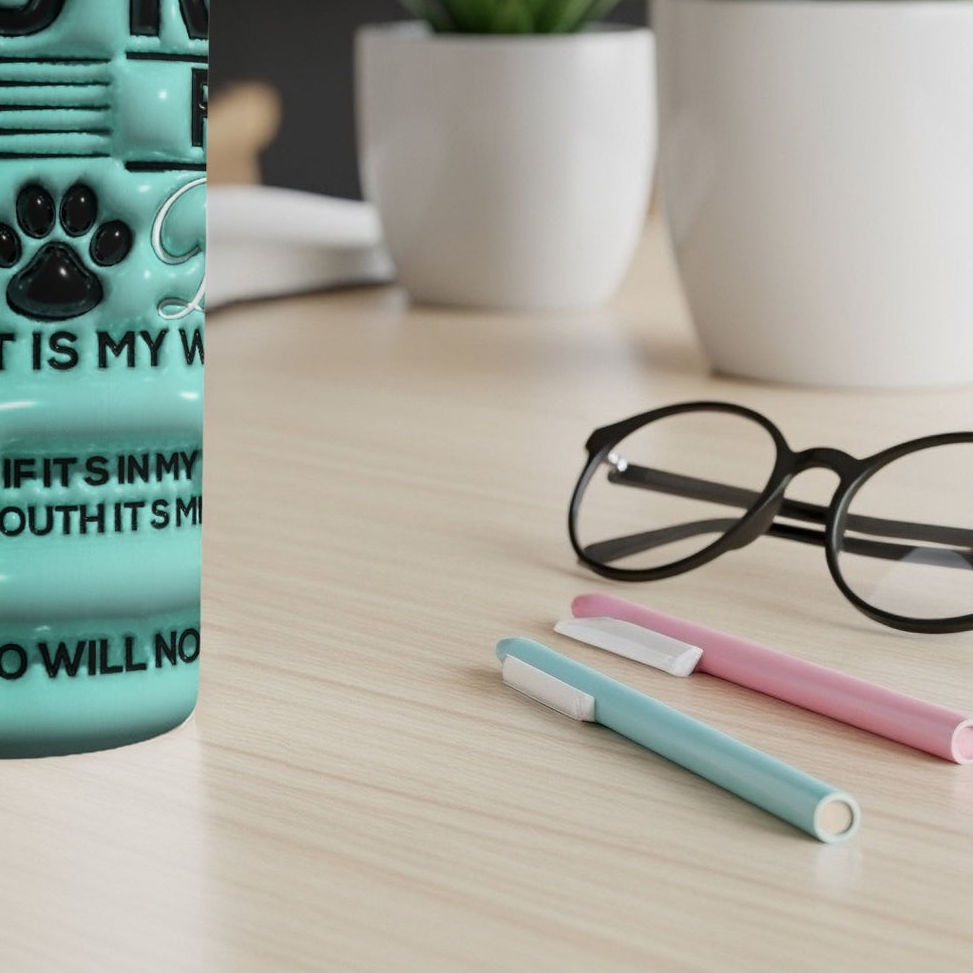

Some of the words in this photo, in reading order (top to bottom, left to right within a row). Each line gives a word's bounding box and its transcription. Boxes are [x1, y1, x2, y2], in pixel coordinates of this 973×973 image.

[32, 331, 78, 370] IS
[96, 328, 169, 369] MY
[2, 457, 37, 489] IF
[117, 453, 149, 485] IN
[155, 449, 199, 483] MY
[38, 633, 147, 679] WILL
